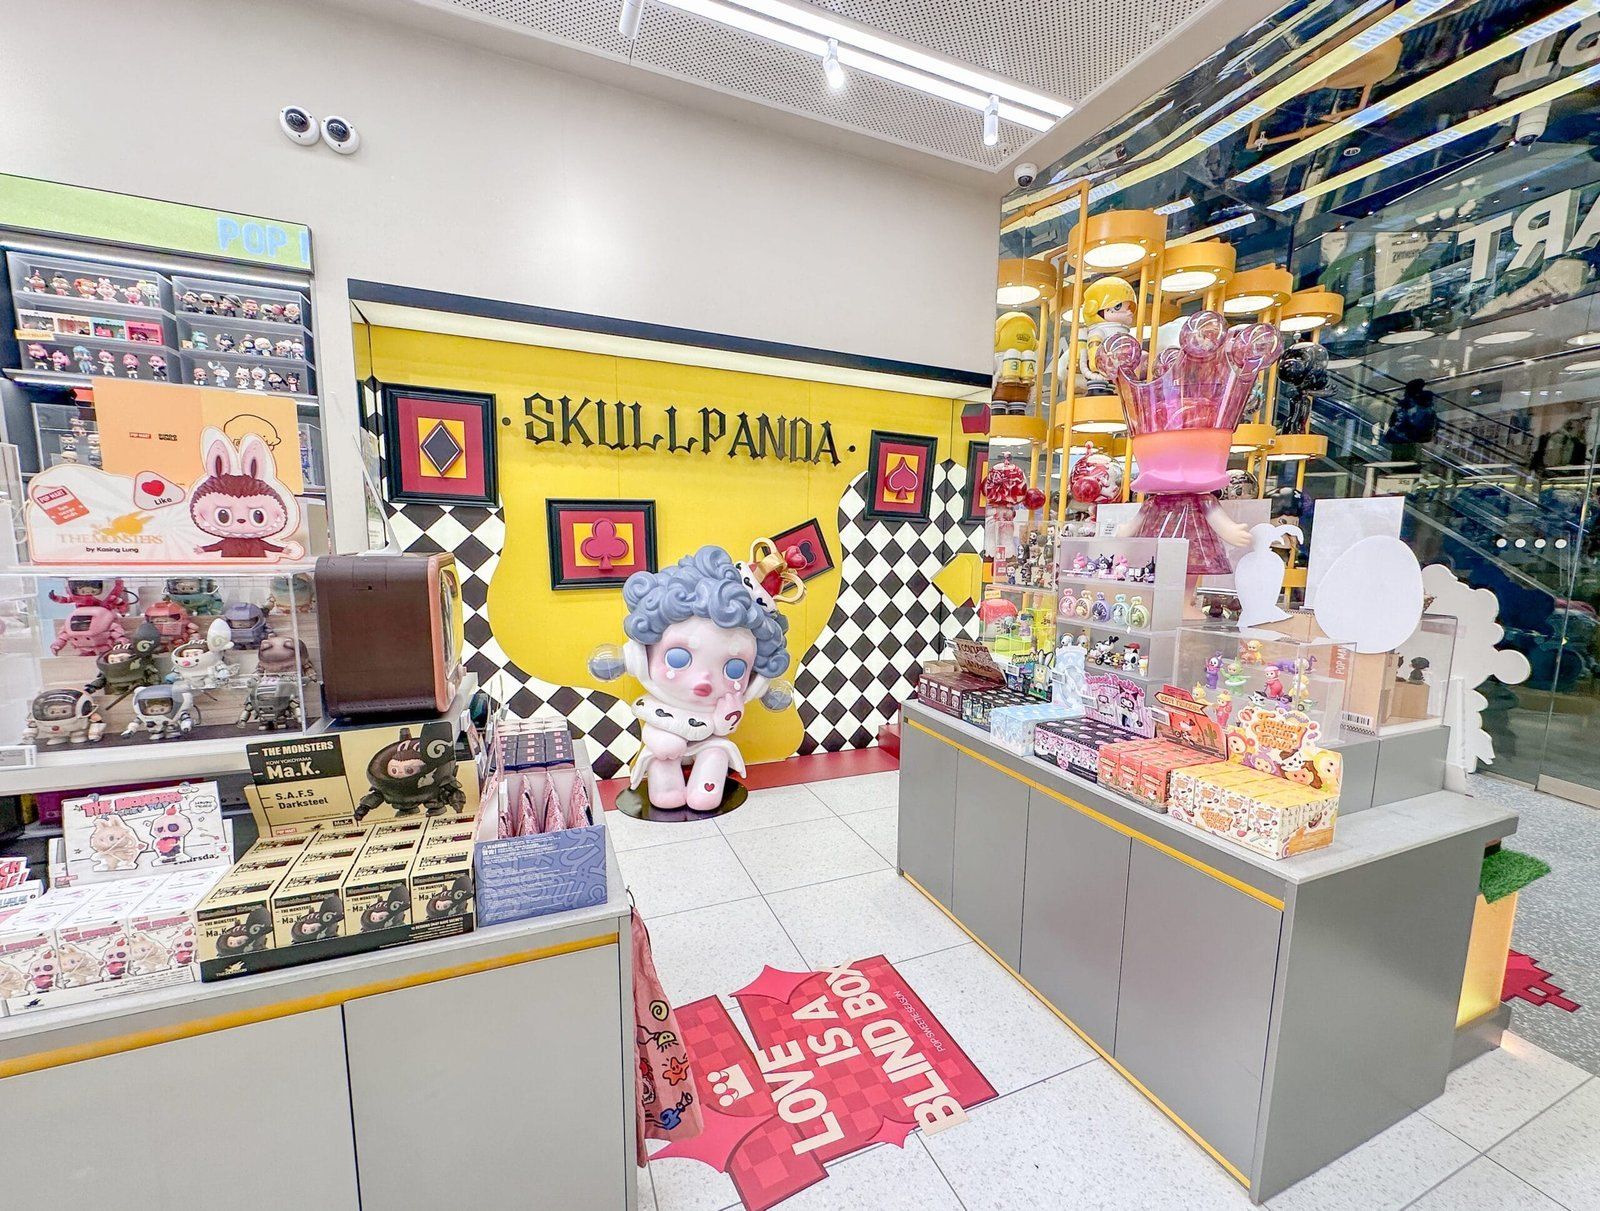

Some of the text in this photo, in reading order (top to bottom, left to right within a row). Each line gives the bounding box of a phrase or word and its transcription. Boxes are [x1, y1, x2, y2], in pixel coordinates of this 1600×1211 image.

[216, 216, 289, 257] POP
[522, 391, 842, 467] SKULLPANDA
[154, 497, 173, 506] Like
[121, 547, 139, 555] Lung
[262, 741, 334, 757] THE MONSTERS
[266, 761, 321, 780] Ma.K.
[275, 789, 315, 801] S.A.F.S
[278, 797, 329, 810] Darksteel
[81, 800, 113, 817] THE
[893, 990, 915, 1014] SEASON
[791, 994, 862, 1067] IS A
[817, 960, 970, 1137] BLIND BOX
[930, 1036, 946, 1053] POP
[752, 1038, 846, 1156] LOVE
